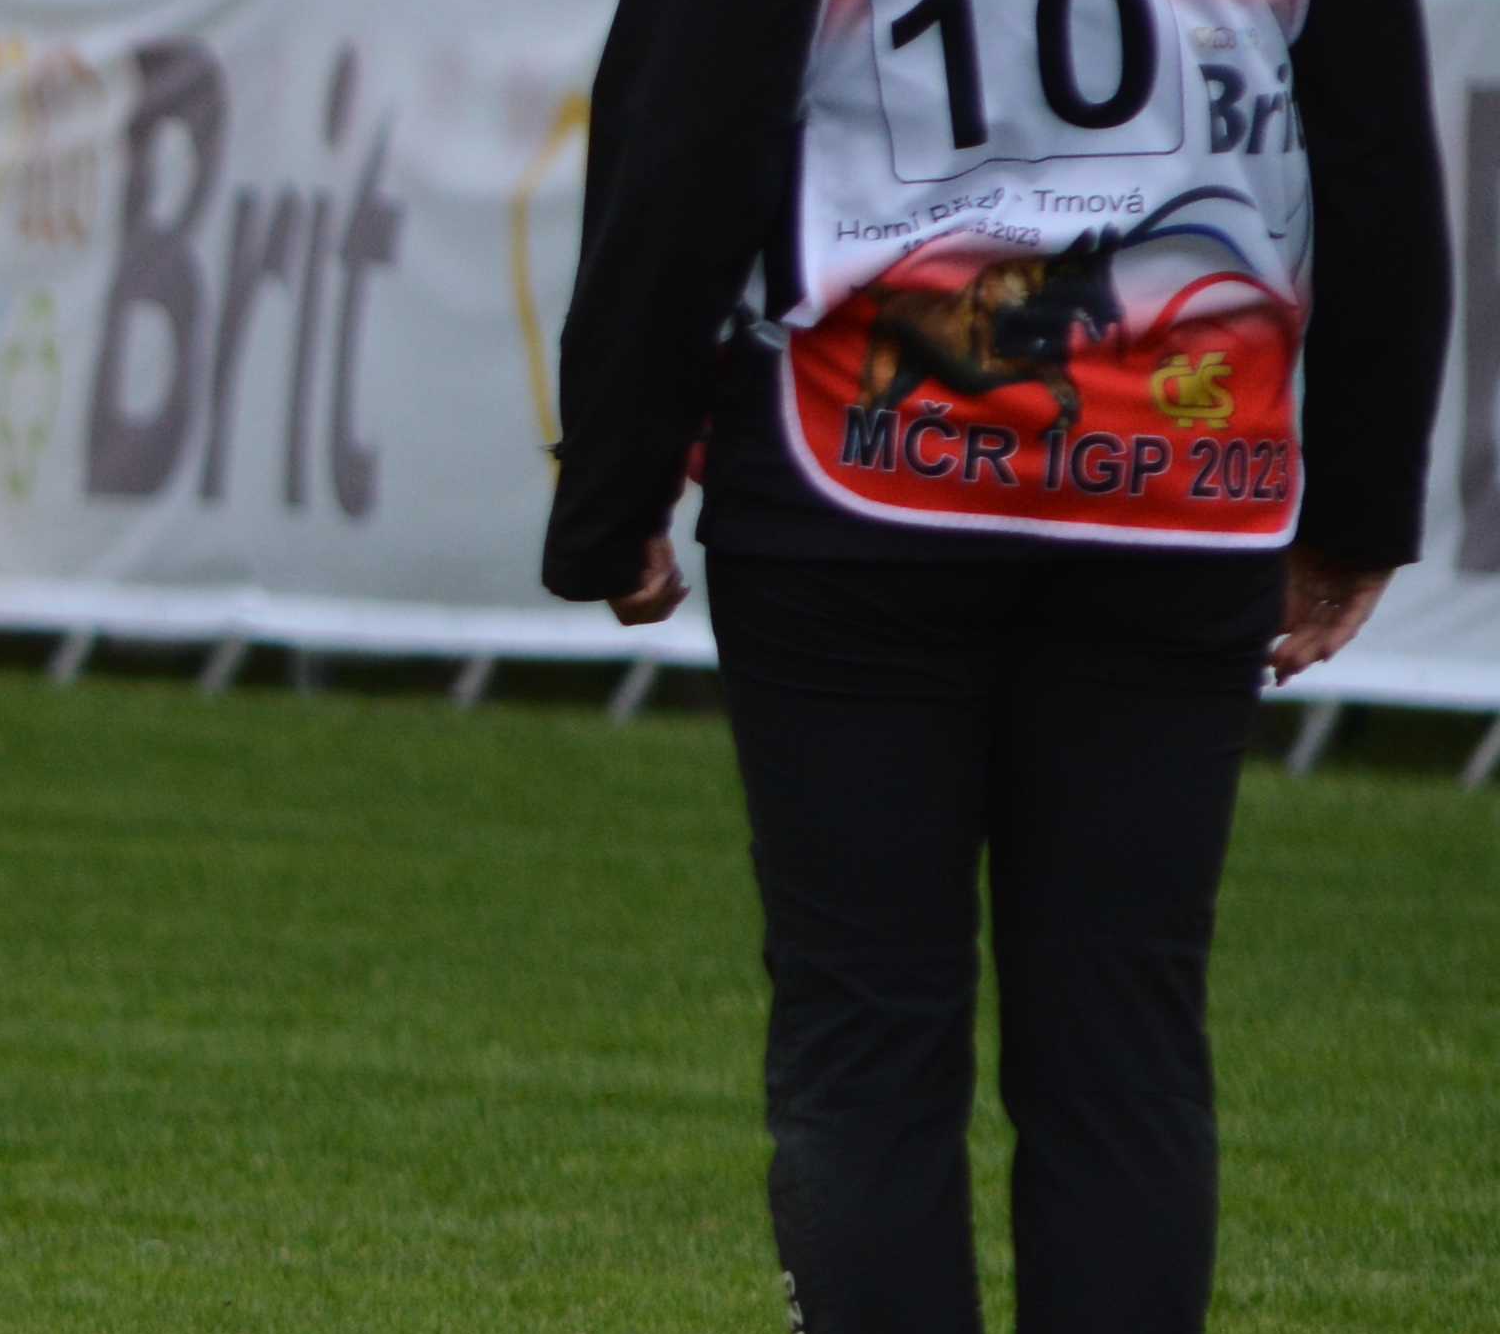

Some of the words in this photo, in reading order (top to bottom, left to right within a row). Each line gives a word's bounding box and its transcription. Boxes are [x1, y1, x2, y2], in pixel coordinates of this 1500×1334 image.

[1198, 62, 1306, 155] Bri
[1034, 187, 1144, 215] Trnová
[86, 33, 403, 520] Brit
[841, 399, 1020, 487] MČR
[1045, 429, 1173, 496] IGP
[1189, 436, 1290, 502] 2023
